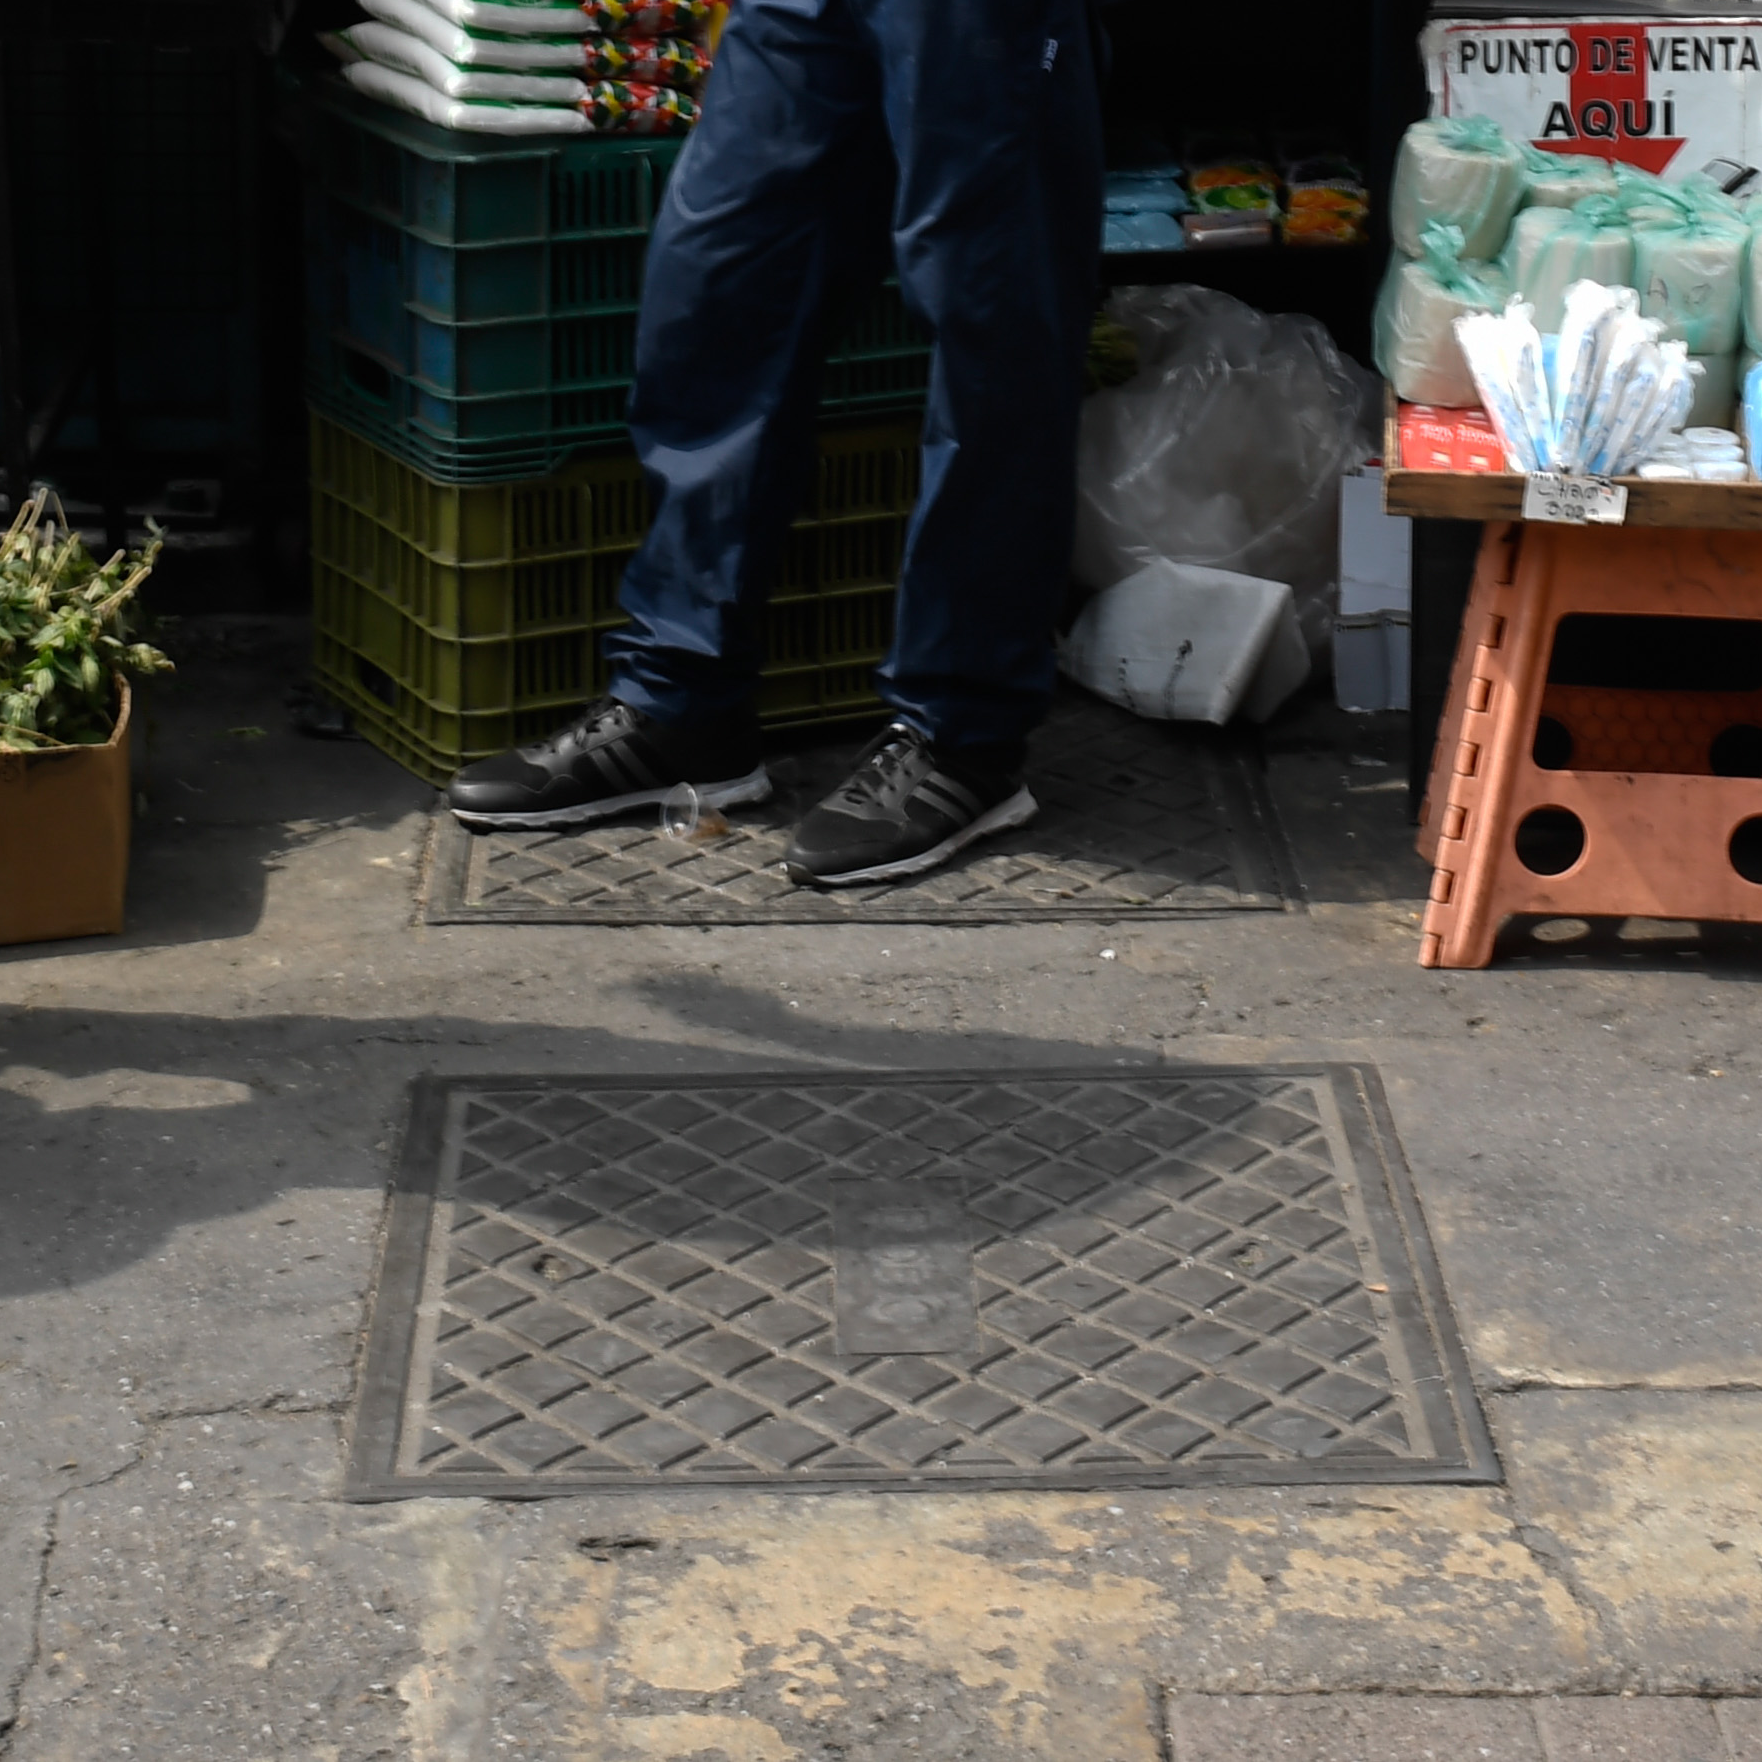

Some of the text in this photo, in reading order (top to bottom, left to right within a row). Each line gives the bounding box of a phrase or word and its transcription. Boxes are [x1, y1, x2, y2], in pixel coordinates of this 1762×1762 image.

[1459, 35, 1761, 75] PUNTO DE VENTA
[1541, 89, 1677, 140] AQUÍ
